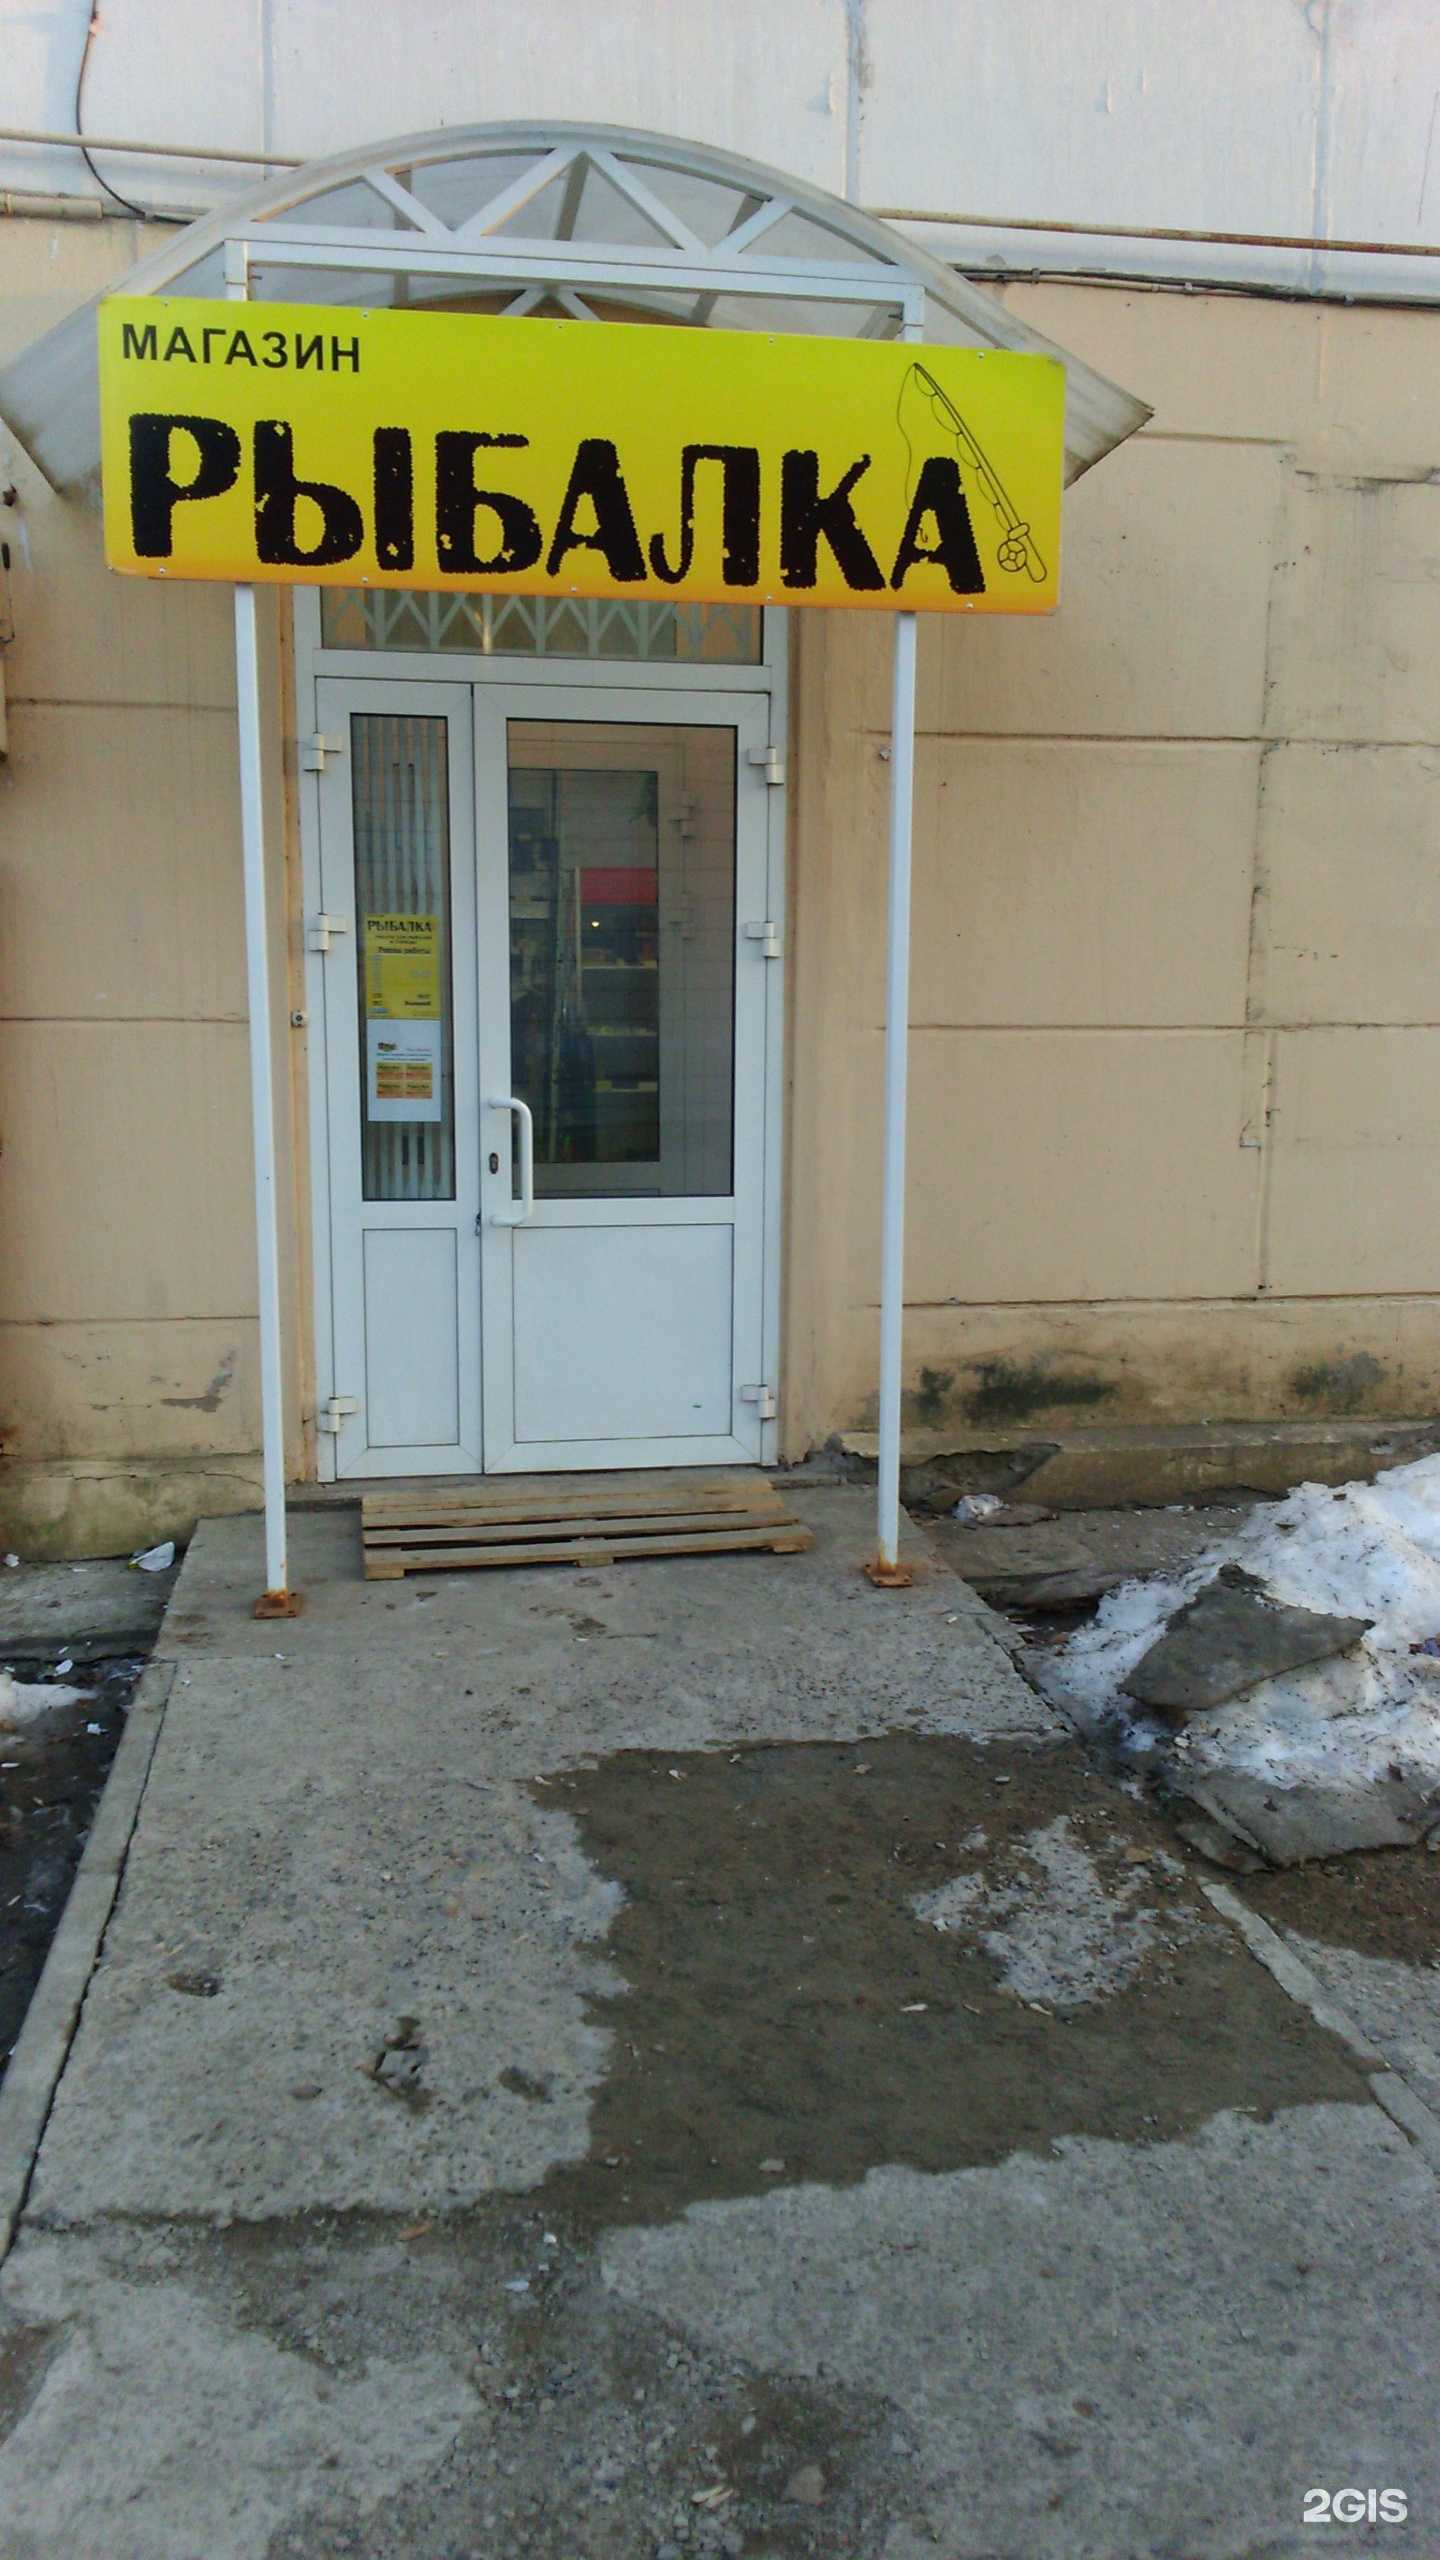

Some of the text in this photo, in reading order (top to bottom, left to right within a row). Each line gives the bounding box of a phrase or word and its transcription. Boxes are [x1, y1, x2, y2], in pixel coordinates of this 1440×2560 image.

[123, 323, 360, 373] МАГАЗИН
[128, 412, 986, 595] РЫБАЛКА
[367, 920, 432, 932] РЫБАЛКА
